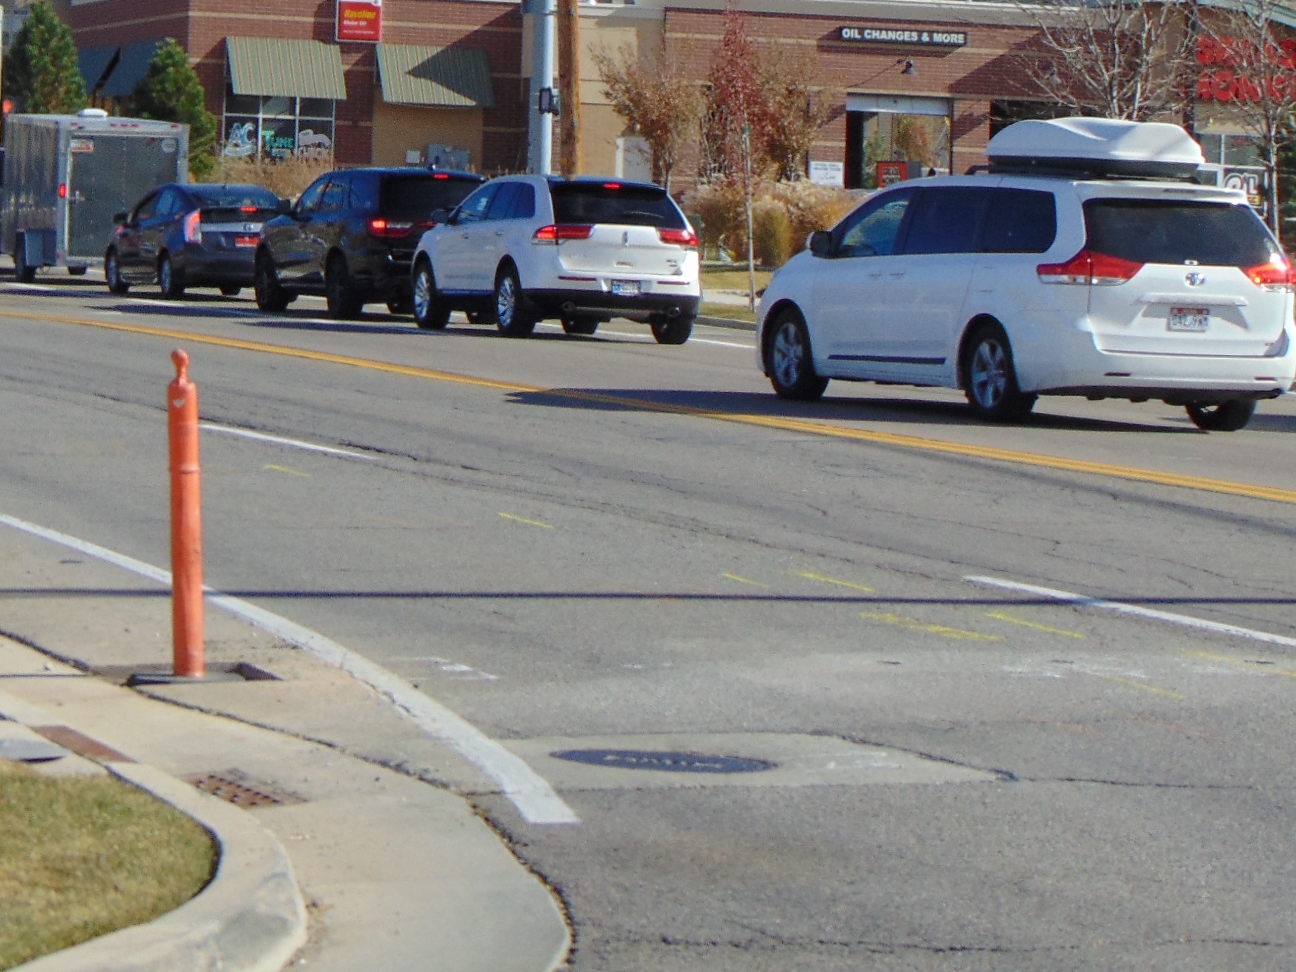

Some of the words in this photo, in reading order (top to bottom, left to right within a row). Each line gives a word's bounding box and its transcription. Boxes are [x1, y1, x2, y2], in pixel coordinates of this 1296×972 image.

[841, 28, 862, 39] OIL
[864, 29, 918, 41] CHANGES
[921, 32, 930, 42] &
[933, 33, 965, 43] MORE
[228, 123, 256, 146] AC
